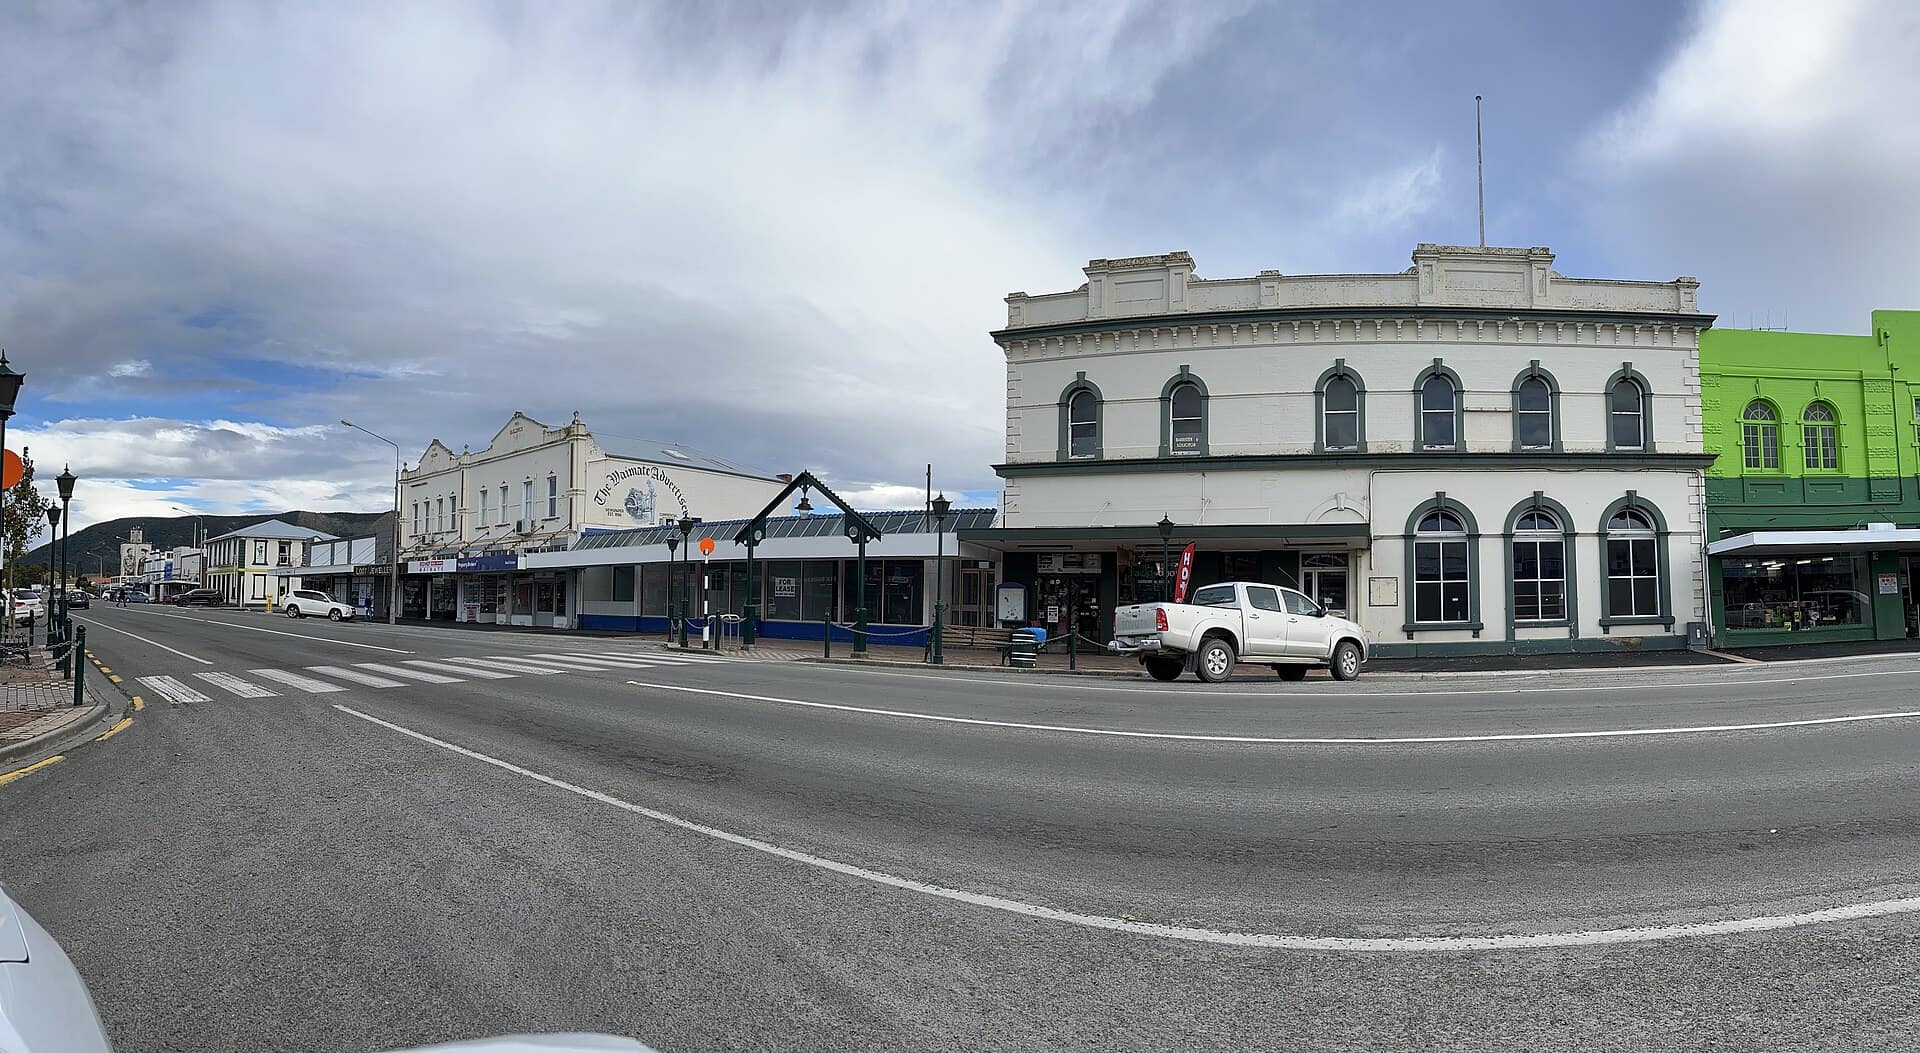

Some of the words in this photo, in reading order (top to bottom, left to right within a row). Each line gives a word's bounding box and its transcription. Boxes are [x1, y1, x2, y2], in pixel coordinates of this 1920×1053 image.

[593, 483, 612, 506] The
[605, 465, 651, 487] Waimate
[650, 466, 690, 519] Advertiser
[775, 585, 795, 593] LEASE
[1180, 552, 1190, 590] HOT
